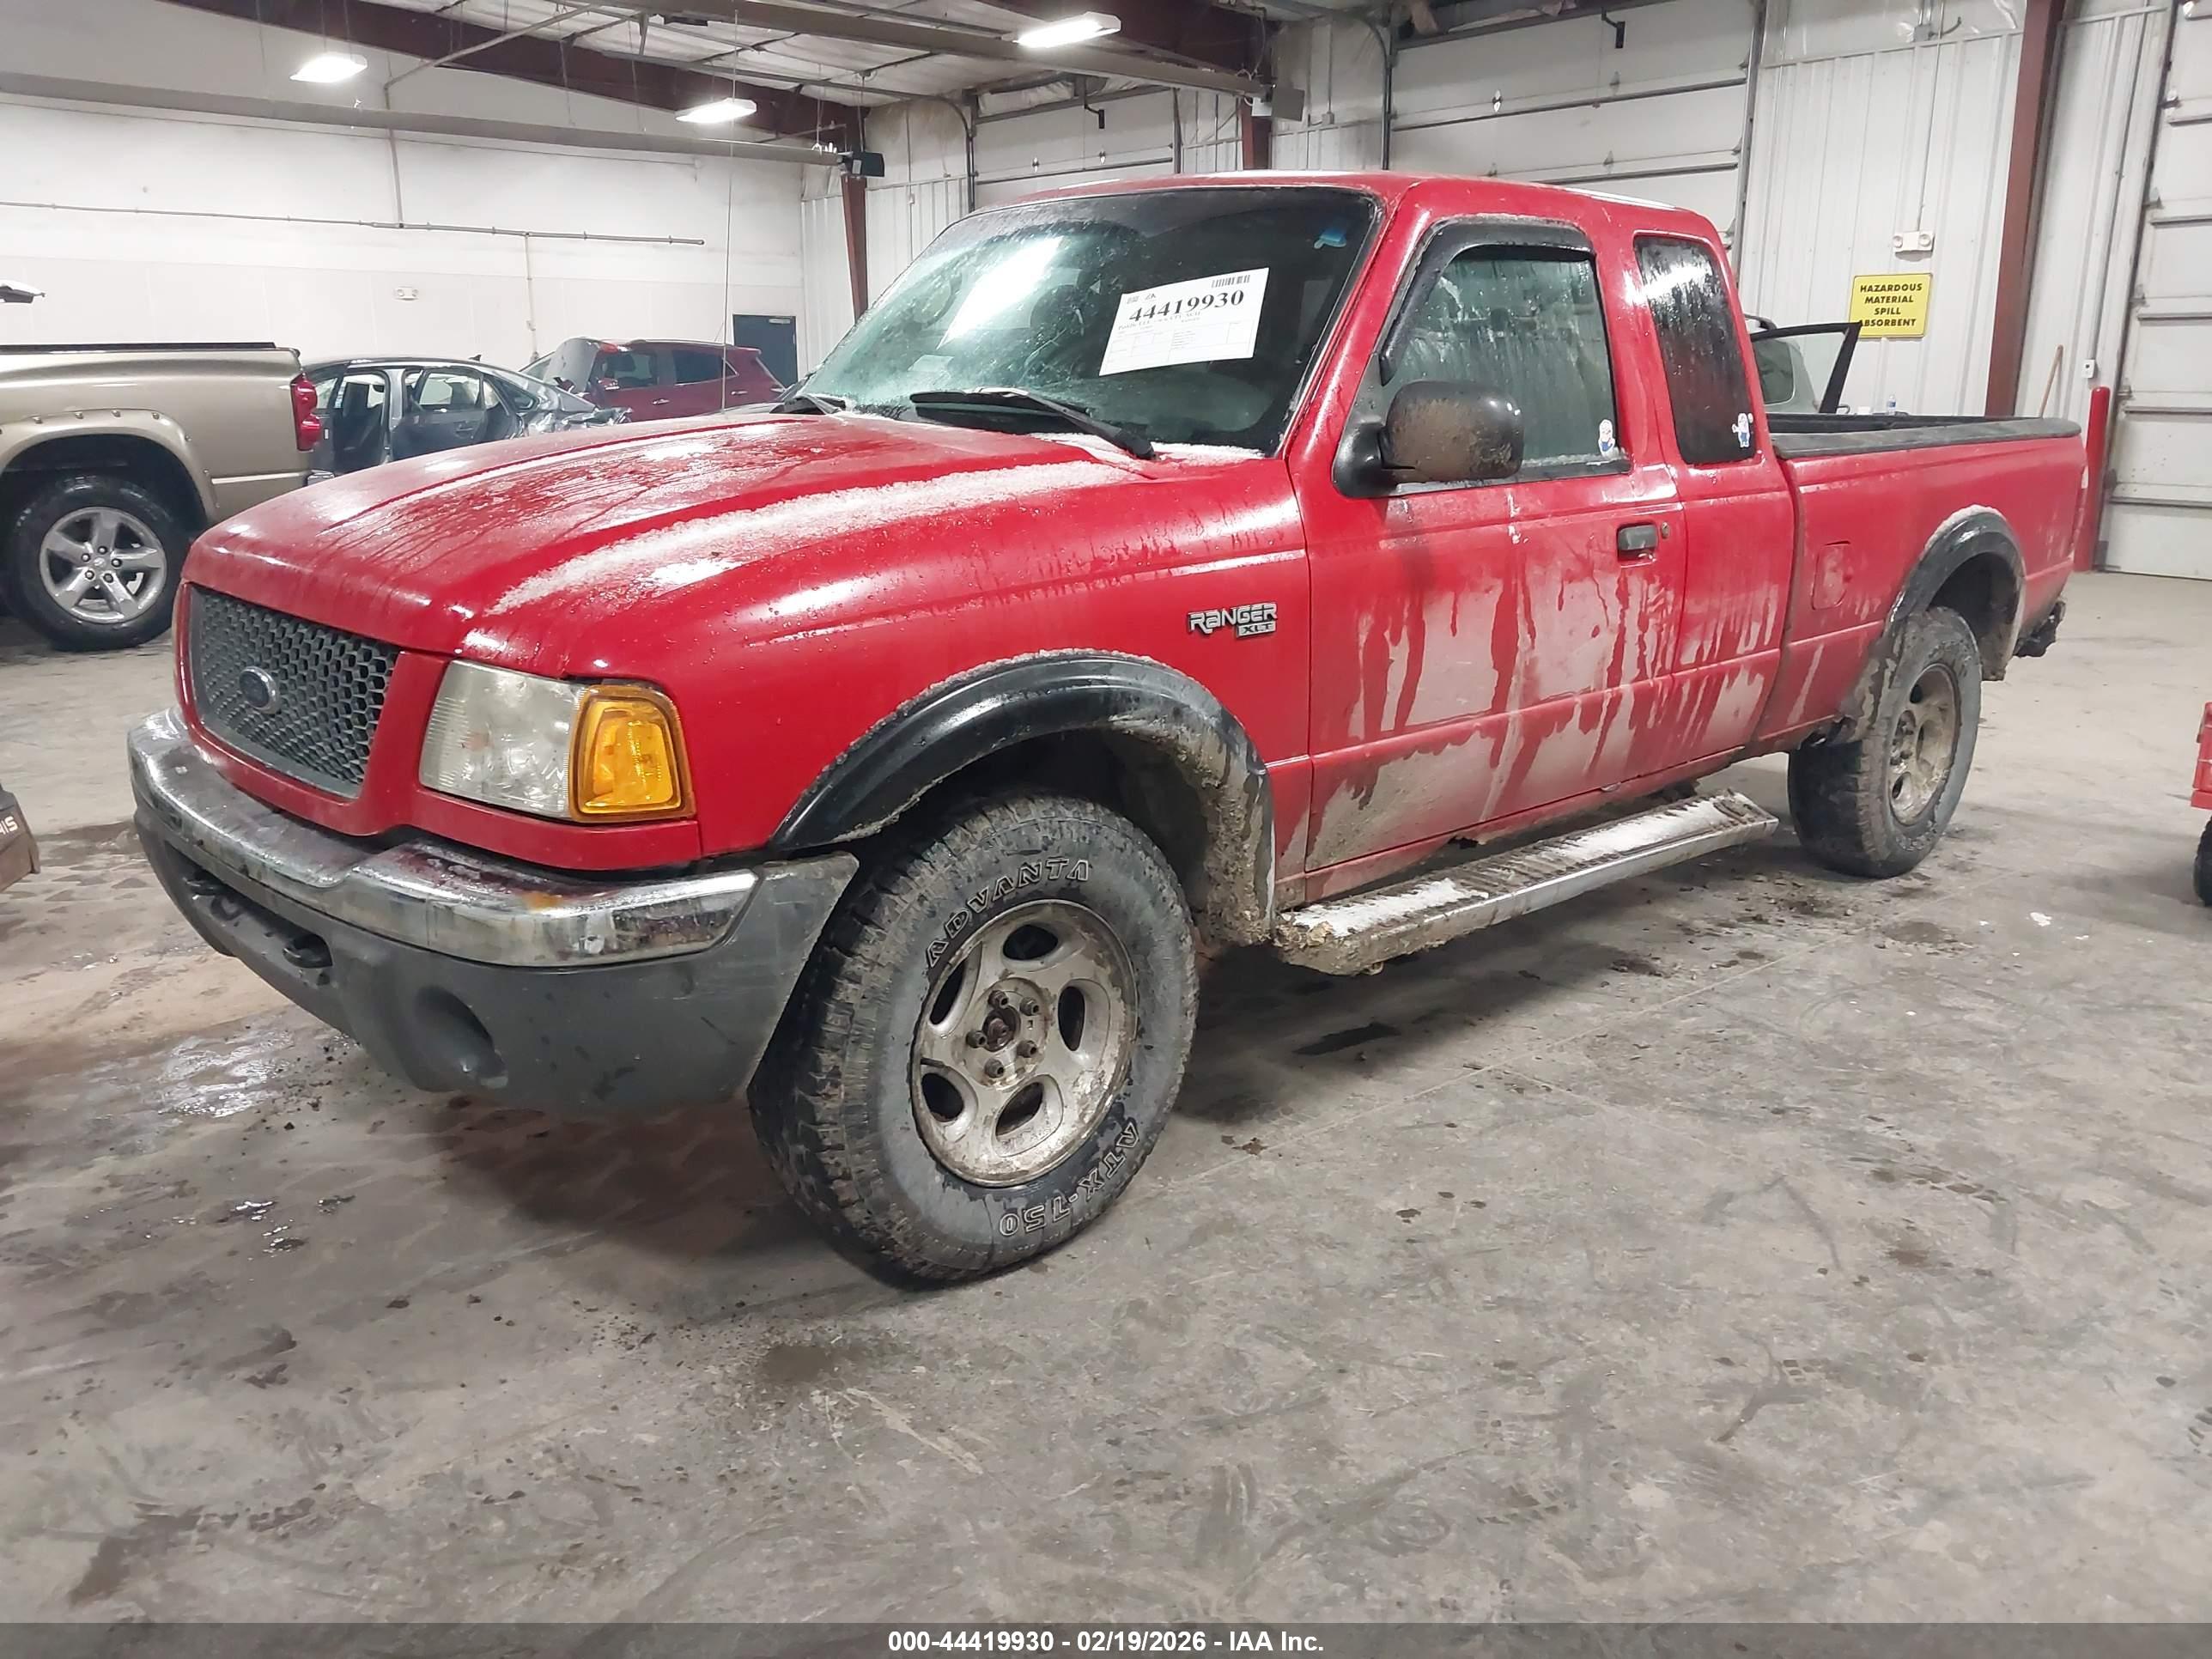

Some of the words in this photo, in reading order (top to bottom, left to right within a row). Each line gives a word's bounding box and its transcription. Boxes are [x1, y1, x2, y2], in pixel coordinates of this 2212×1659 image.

[1860, 283, 1923, 293] HAZARDOUS
[1864, 295, 1914, 304] MATERIAL
[1128, 289, 1244, 322] 44419930
[1188, 602, 1278, 634] RANGER
[1241, 623, 1273, 635] XLT
[927, 859, 1089, 969] ADVANTA
[999, 1121, 1140, 1237] ATX-750
